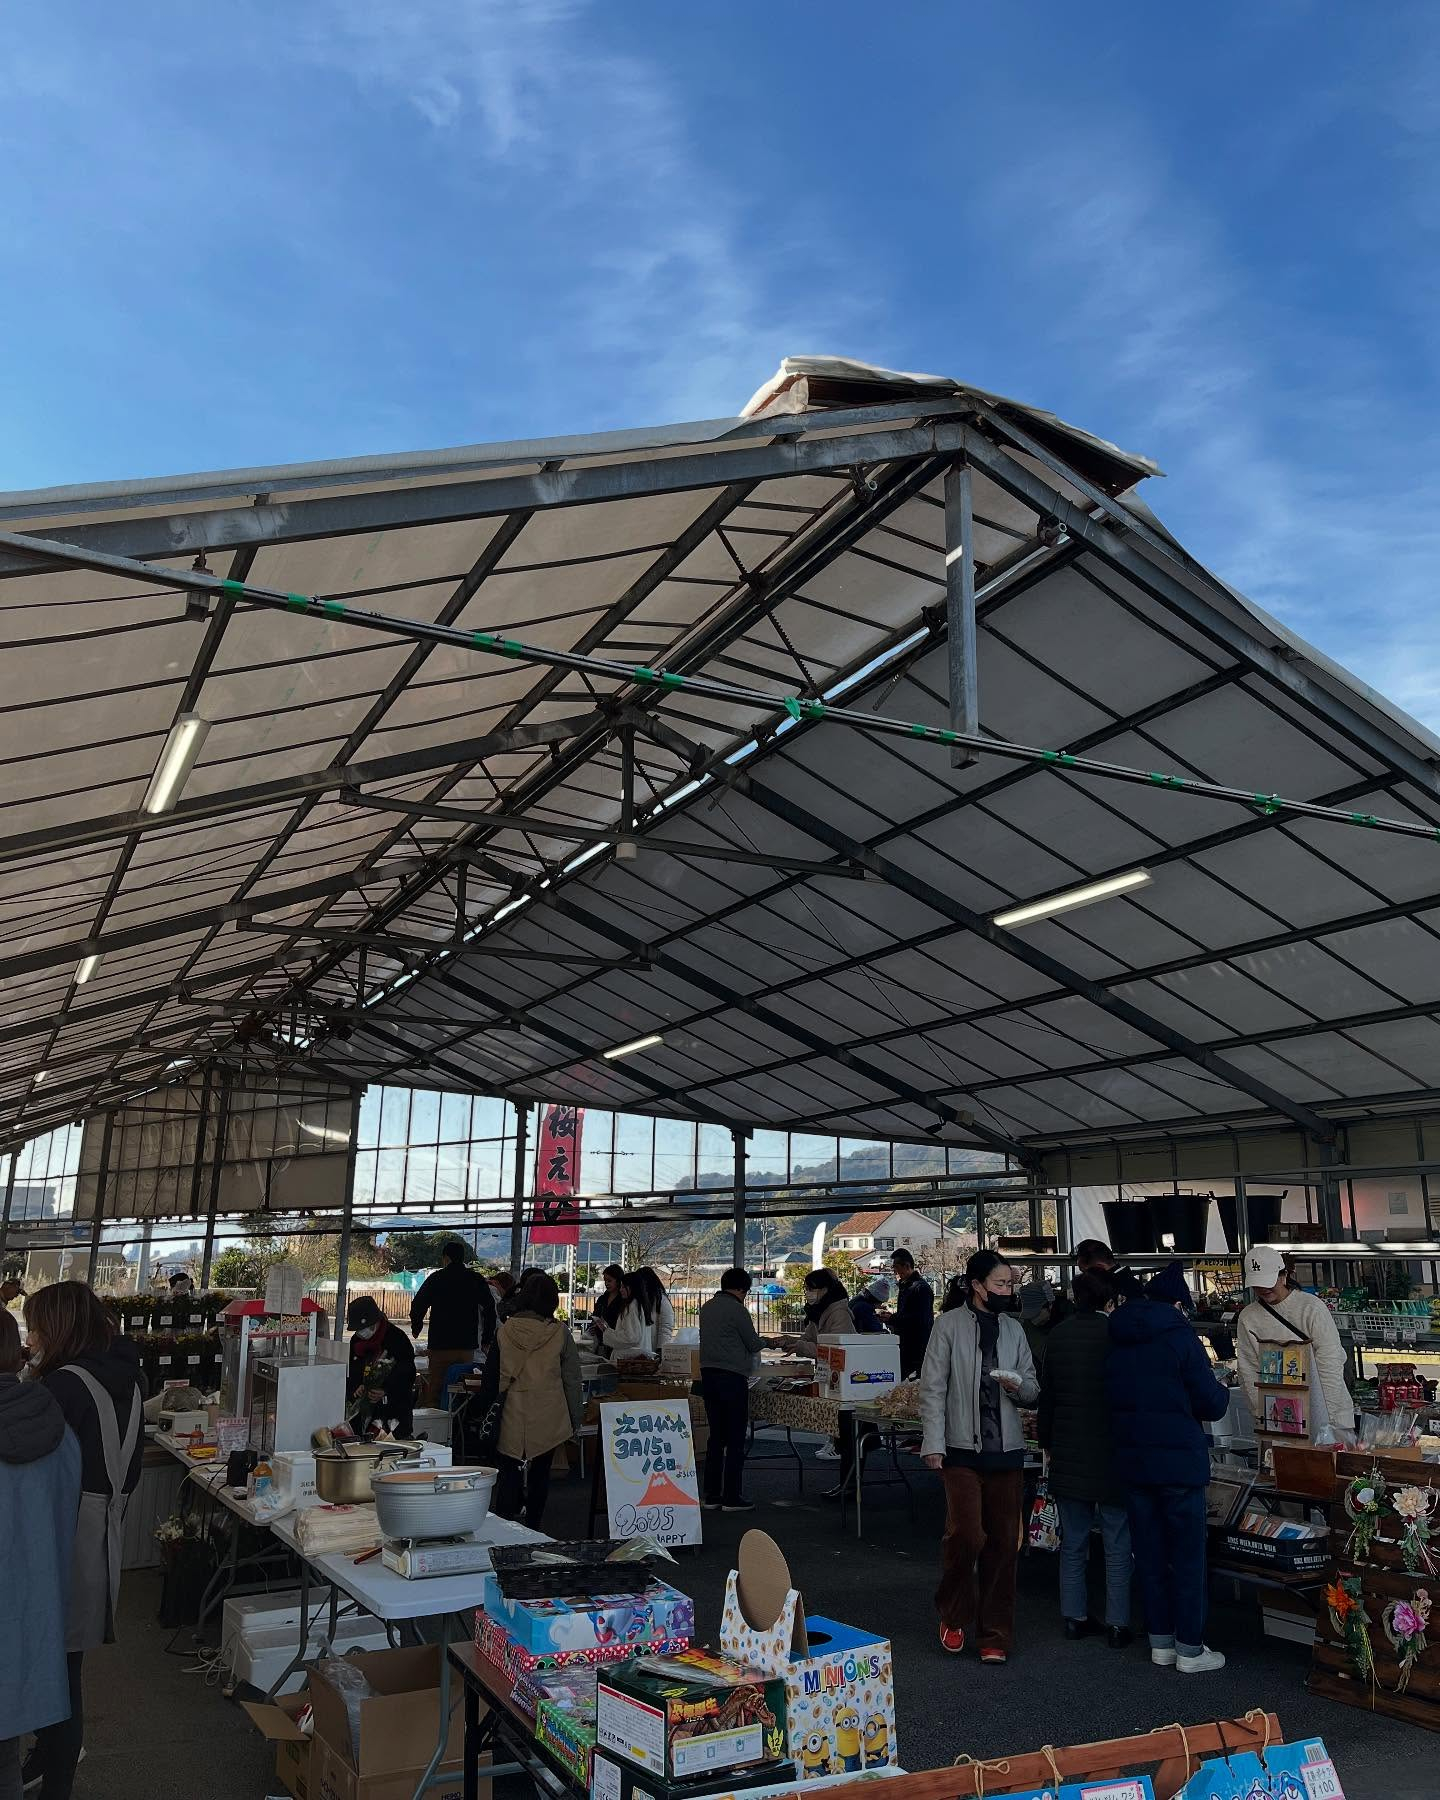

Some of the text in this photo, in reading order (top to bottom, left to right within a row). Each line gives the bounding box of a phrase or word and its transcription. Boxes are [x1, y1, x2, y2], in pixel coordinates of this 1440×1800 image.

[1251, 1258, 1261, 1272] LA
[615, 1503, 674, 1537] 2025
[804, 1655, 881, 1695] MINIONS
